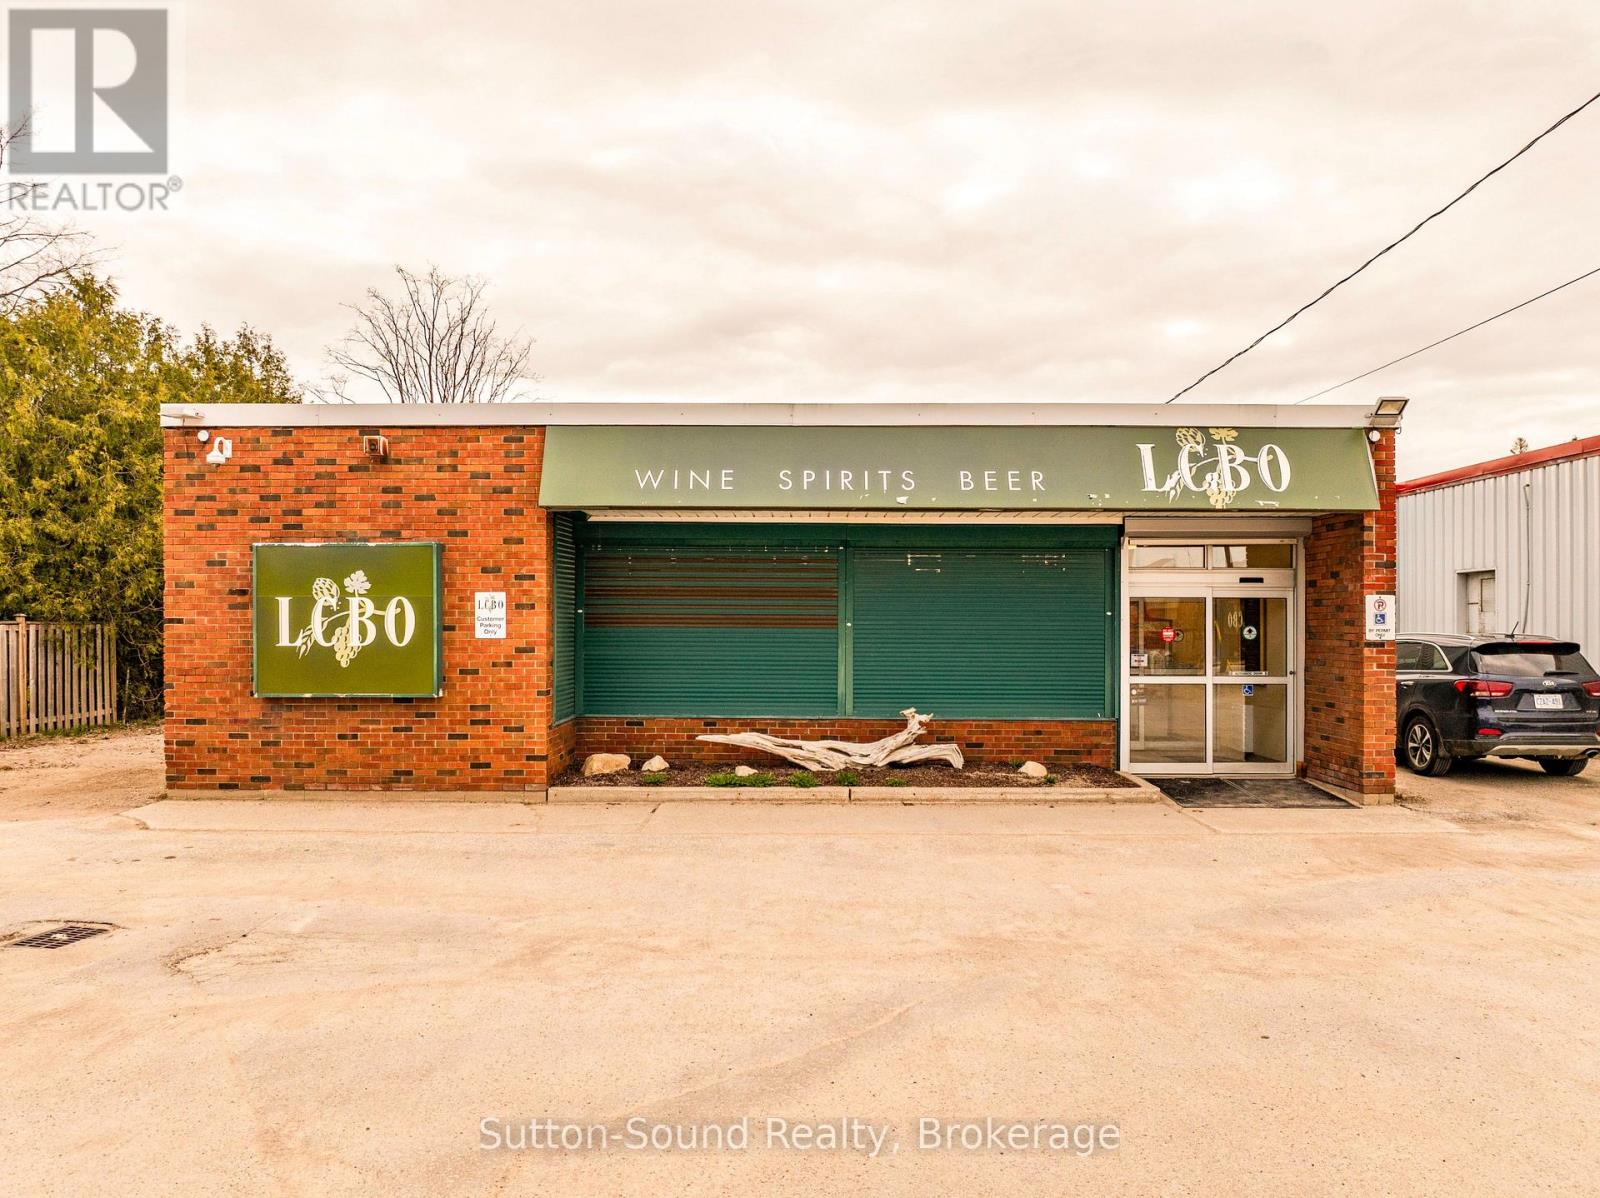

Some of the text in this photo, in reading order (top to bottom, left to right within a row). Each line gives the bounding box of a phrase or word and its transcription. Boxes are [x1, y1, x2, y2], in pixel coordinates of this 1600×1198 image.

[635, 469, 1046, 491] WINE SPIRITS BEER
[1136, 443, 1291, 492] LCBO
[275, 596, 416, 647] LCBO
[478, 599, 504, 609] LCBO
